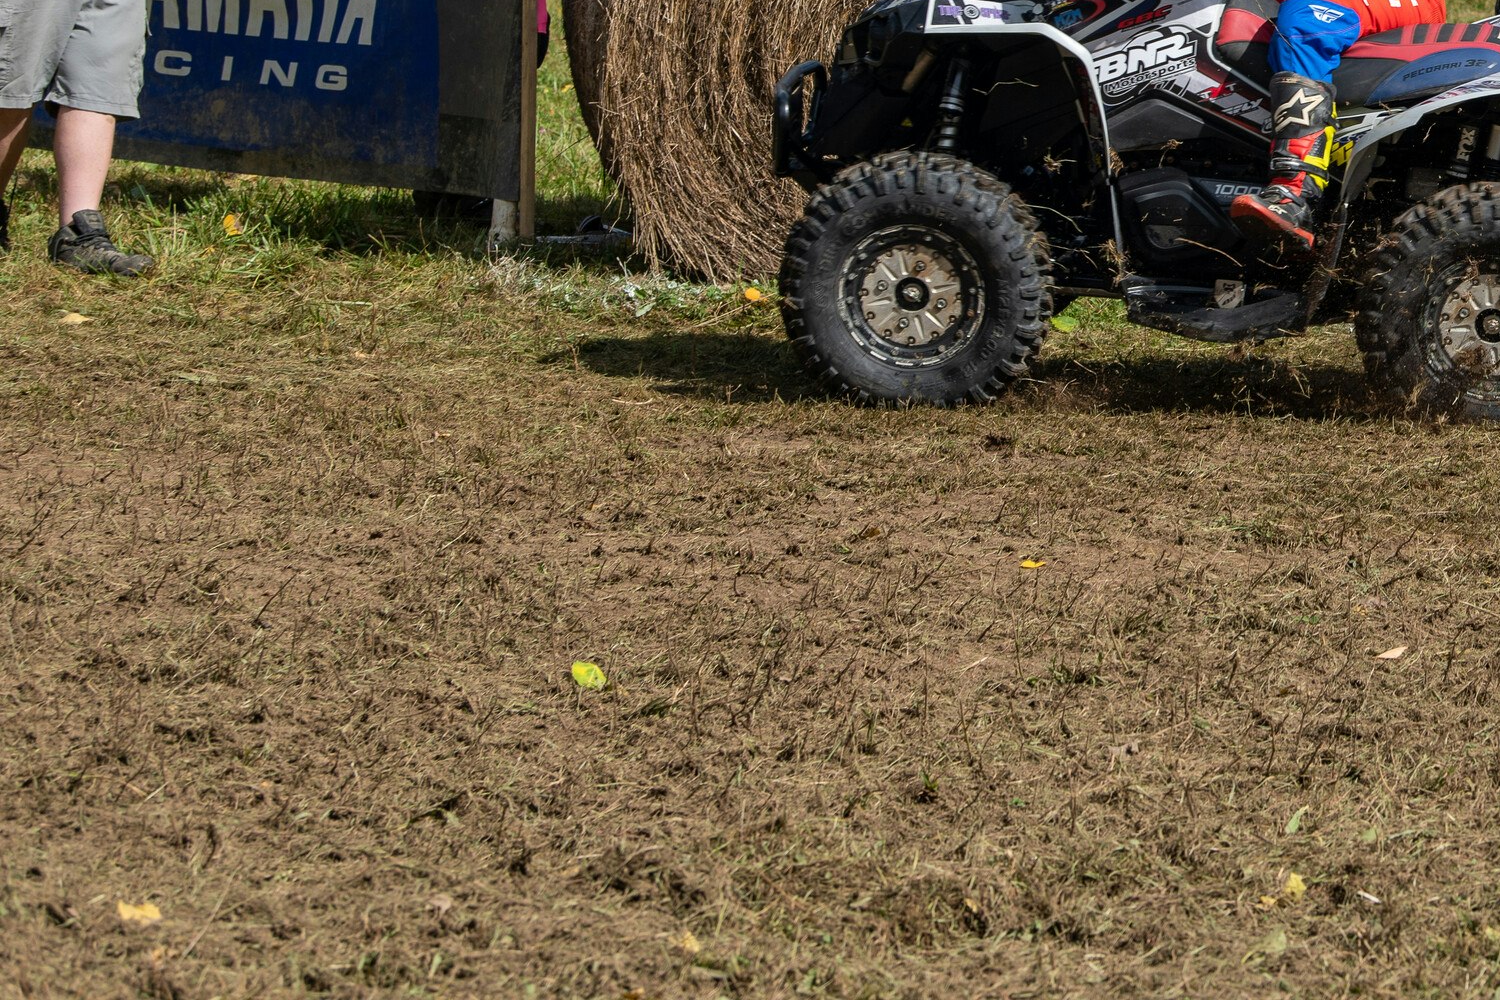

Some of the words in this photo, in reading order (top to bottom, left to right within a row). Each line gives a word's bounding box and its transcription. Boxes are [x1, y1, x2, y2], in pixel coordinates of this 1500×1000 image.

[153, 49, 349, 92] CING
[1098, 32, 1197, 81] BNR
[1104, 57, 1197, 93] Motorsports
[1402, 61, 1462, 82] PECORARI
[1457, 126, 1478, 163] FOX
